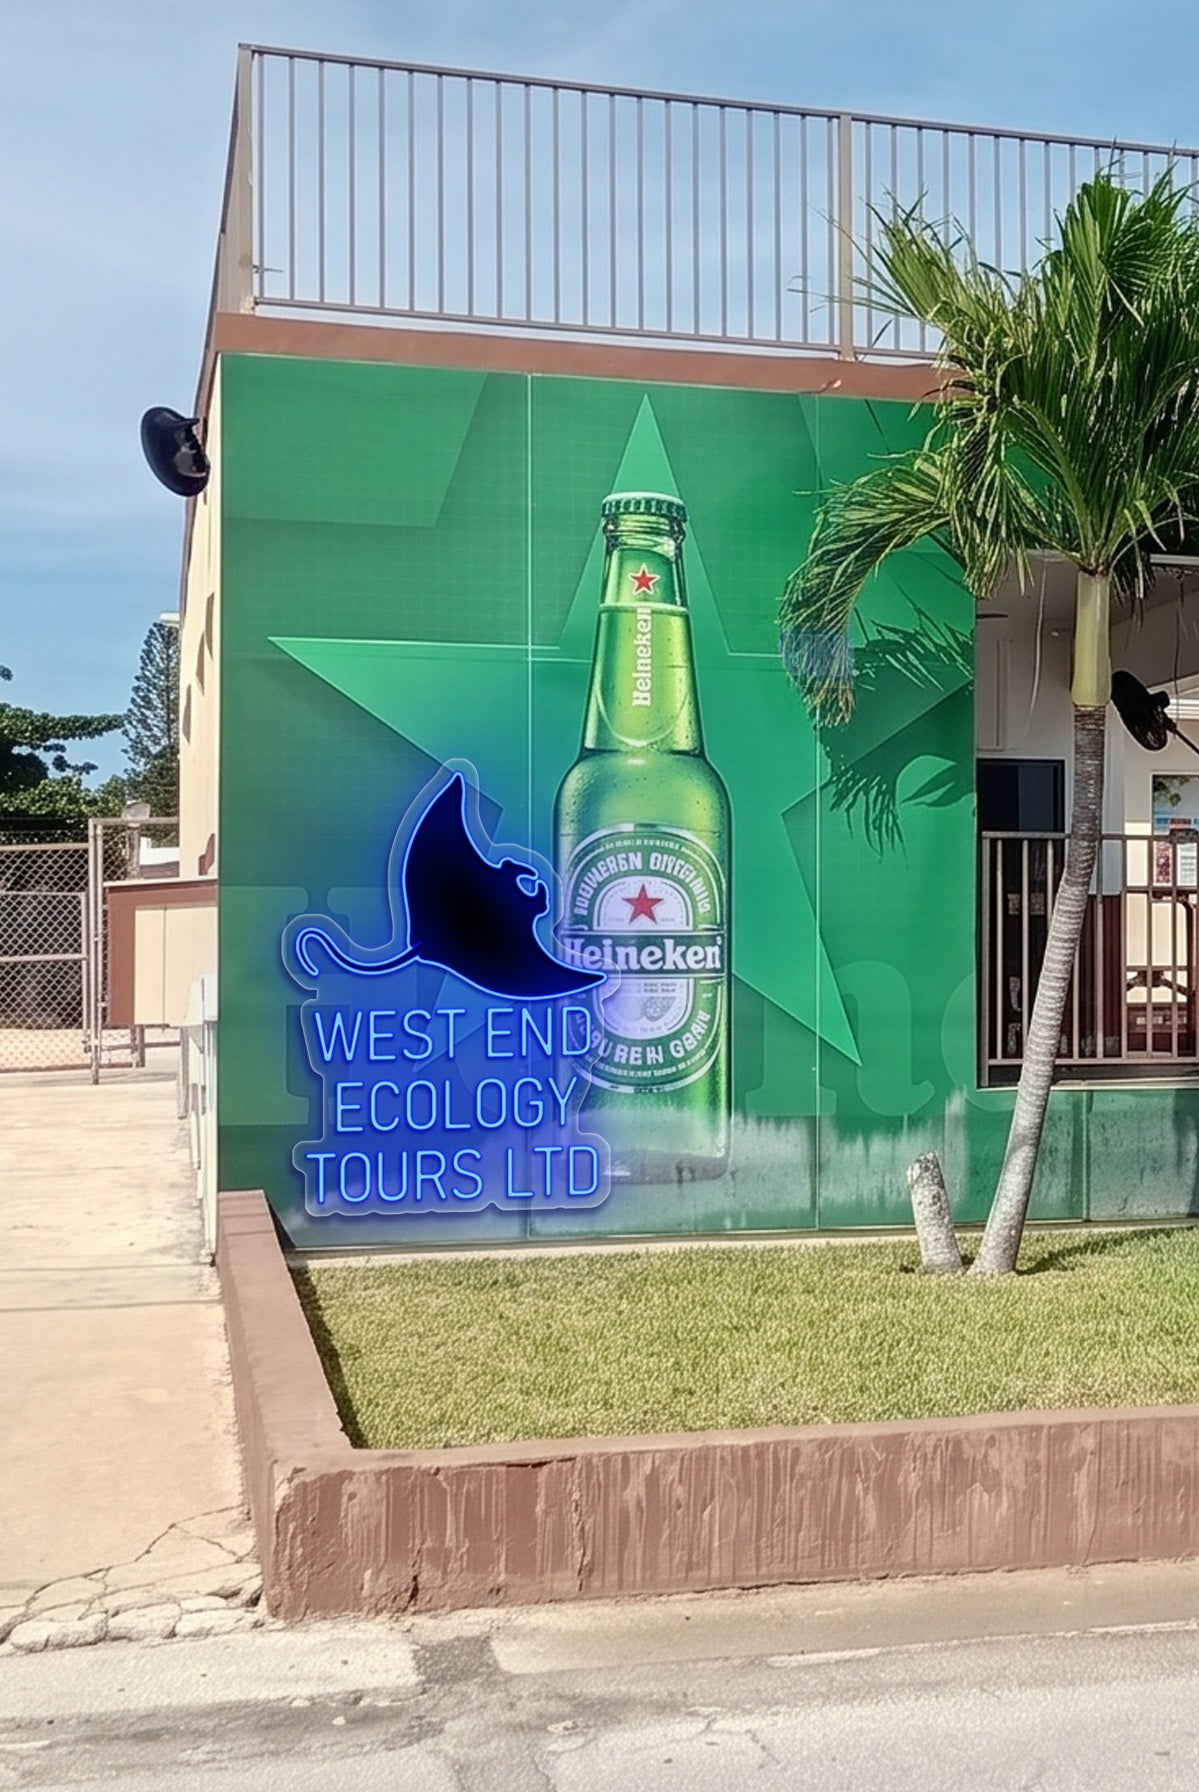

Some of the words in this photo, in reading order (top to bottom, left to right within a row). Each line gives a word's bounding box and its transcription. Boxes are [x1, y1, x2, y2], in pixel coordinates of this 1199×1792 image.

[562, 937, 721, 970] Heineken
[314, 1008, 466, 1062] WEST
[486, 1005, 592, 1059] END
[335, 1075, 578, 1133] ECOLOGY
[306, 1149, 484, 1204] TOURS
[506, 1144, 600, 1198] LTD
